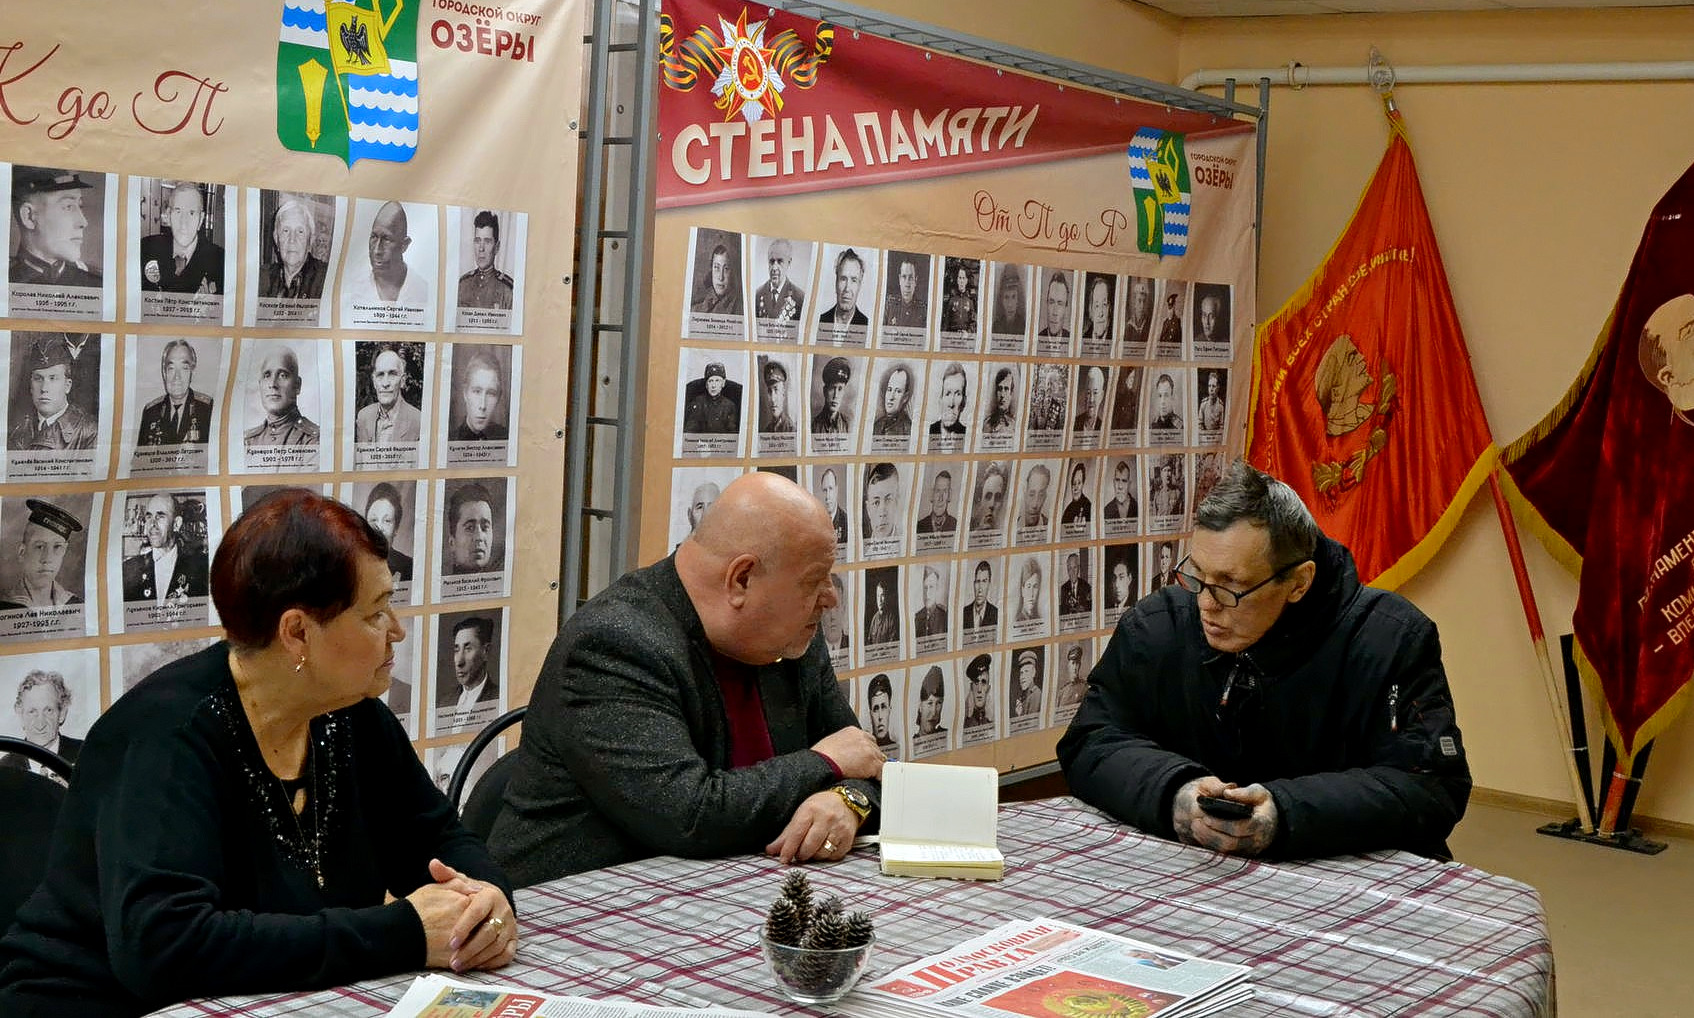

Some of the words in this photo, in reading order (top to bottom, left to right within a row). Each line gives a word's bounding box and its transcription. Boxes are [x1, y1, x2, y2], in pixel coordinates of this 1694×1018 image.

[431, 18, 535, 62] ОЗЁРЫ
[506, 11, 542, 26] ОКРУГ
[132, 70, 229, 136] П
[671, 114, 855, 185] СТЕНА
[854, 104, 1040, 166] ПАМЯТИ
[1194, 163, 1234, 190] ОЗЁРЫ
[973, 190, 1011, 232] От
[1017, 199, 1053, 240] П
[1056, 221, 1081, 252] до
[1085, 208, 1128, 248] Я
